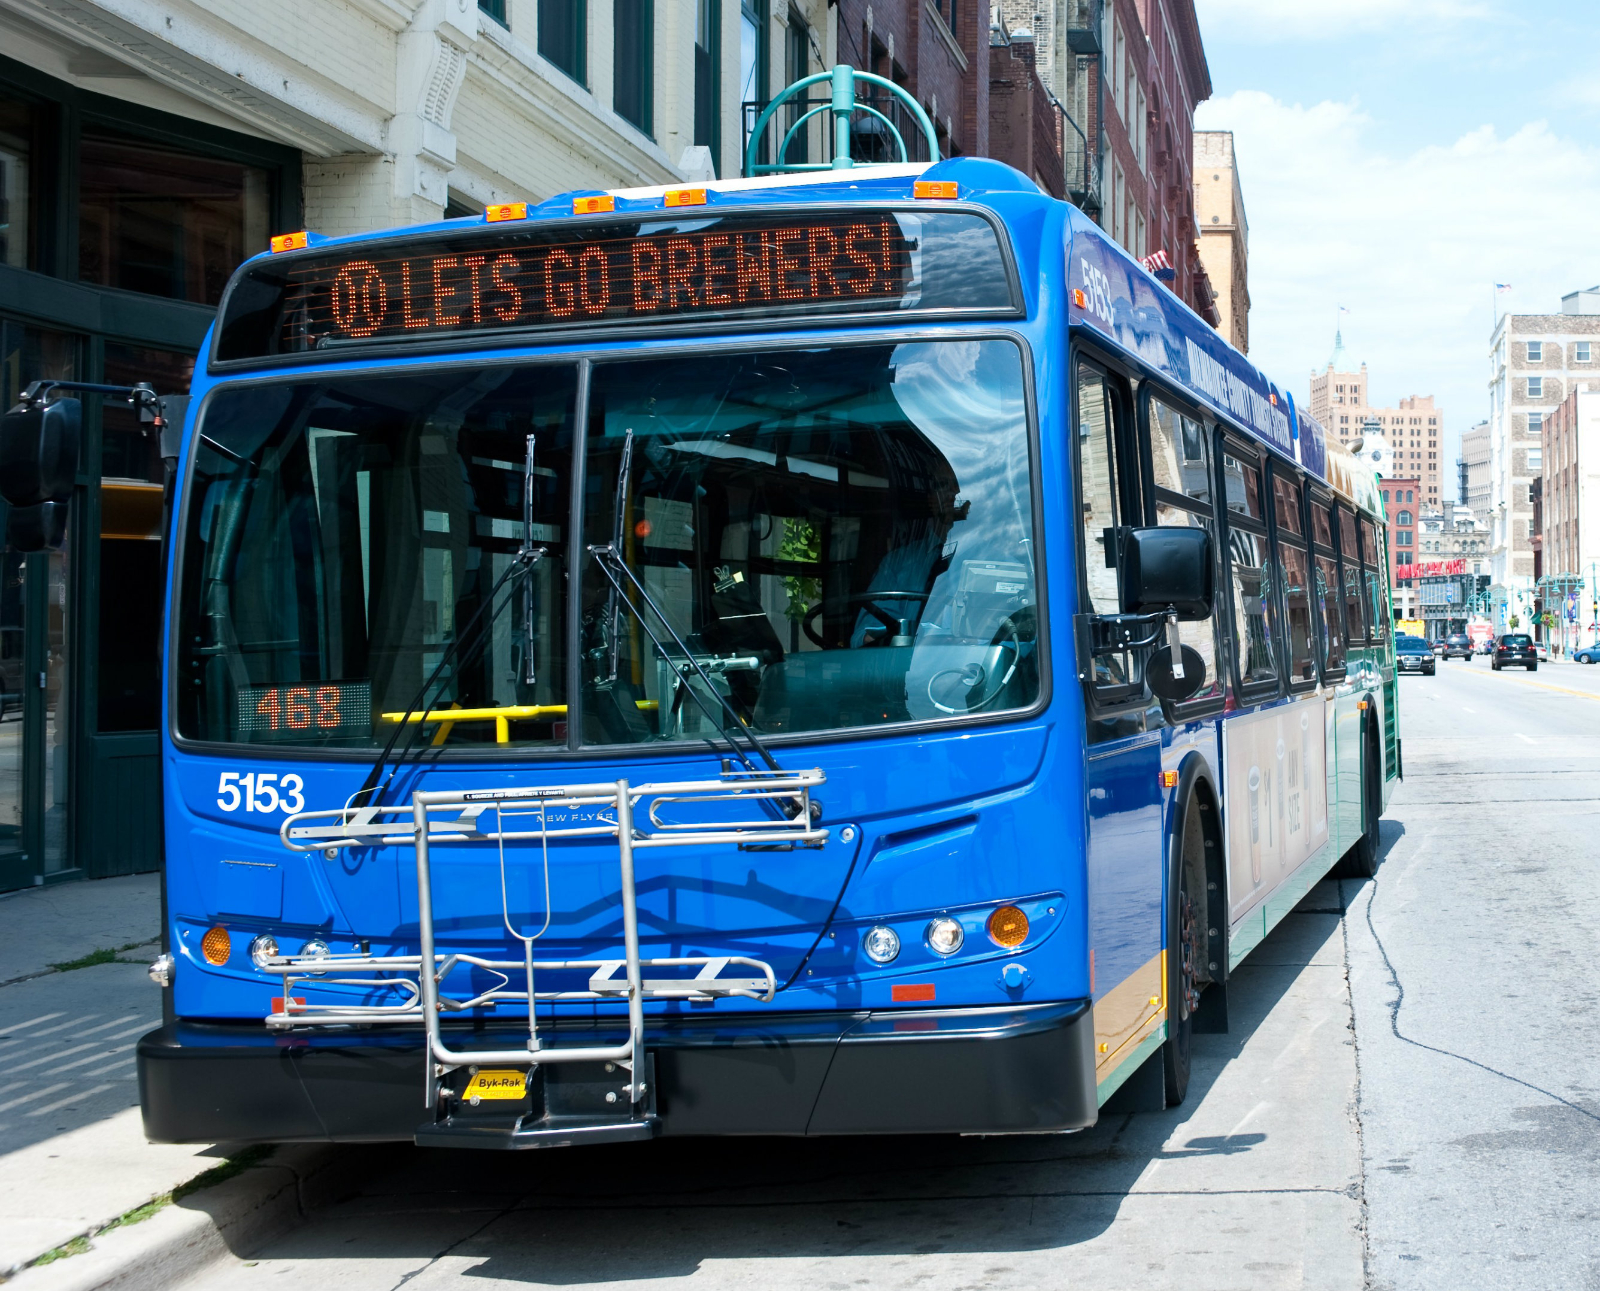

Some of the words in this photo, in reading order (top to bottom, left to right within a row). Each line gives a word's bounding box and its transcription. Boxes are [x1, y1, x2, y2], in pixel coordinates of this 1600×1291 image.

[401, 253, 523, 328] LETS
[544, 245, 611, 316] GO
[632, 222, 893, 311] BREWERS!
[1081, 257, 1114, 327] 5153
[257, 685, 341, 730] 468
[216, 771, 305, 815] 5153
[536, 813, 568, 823] NEW
[571, 812, 613, 822] FLYER
[478, 1078, 521, 1089] Byk-Rak
